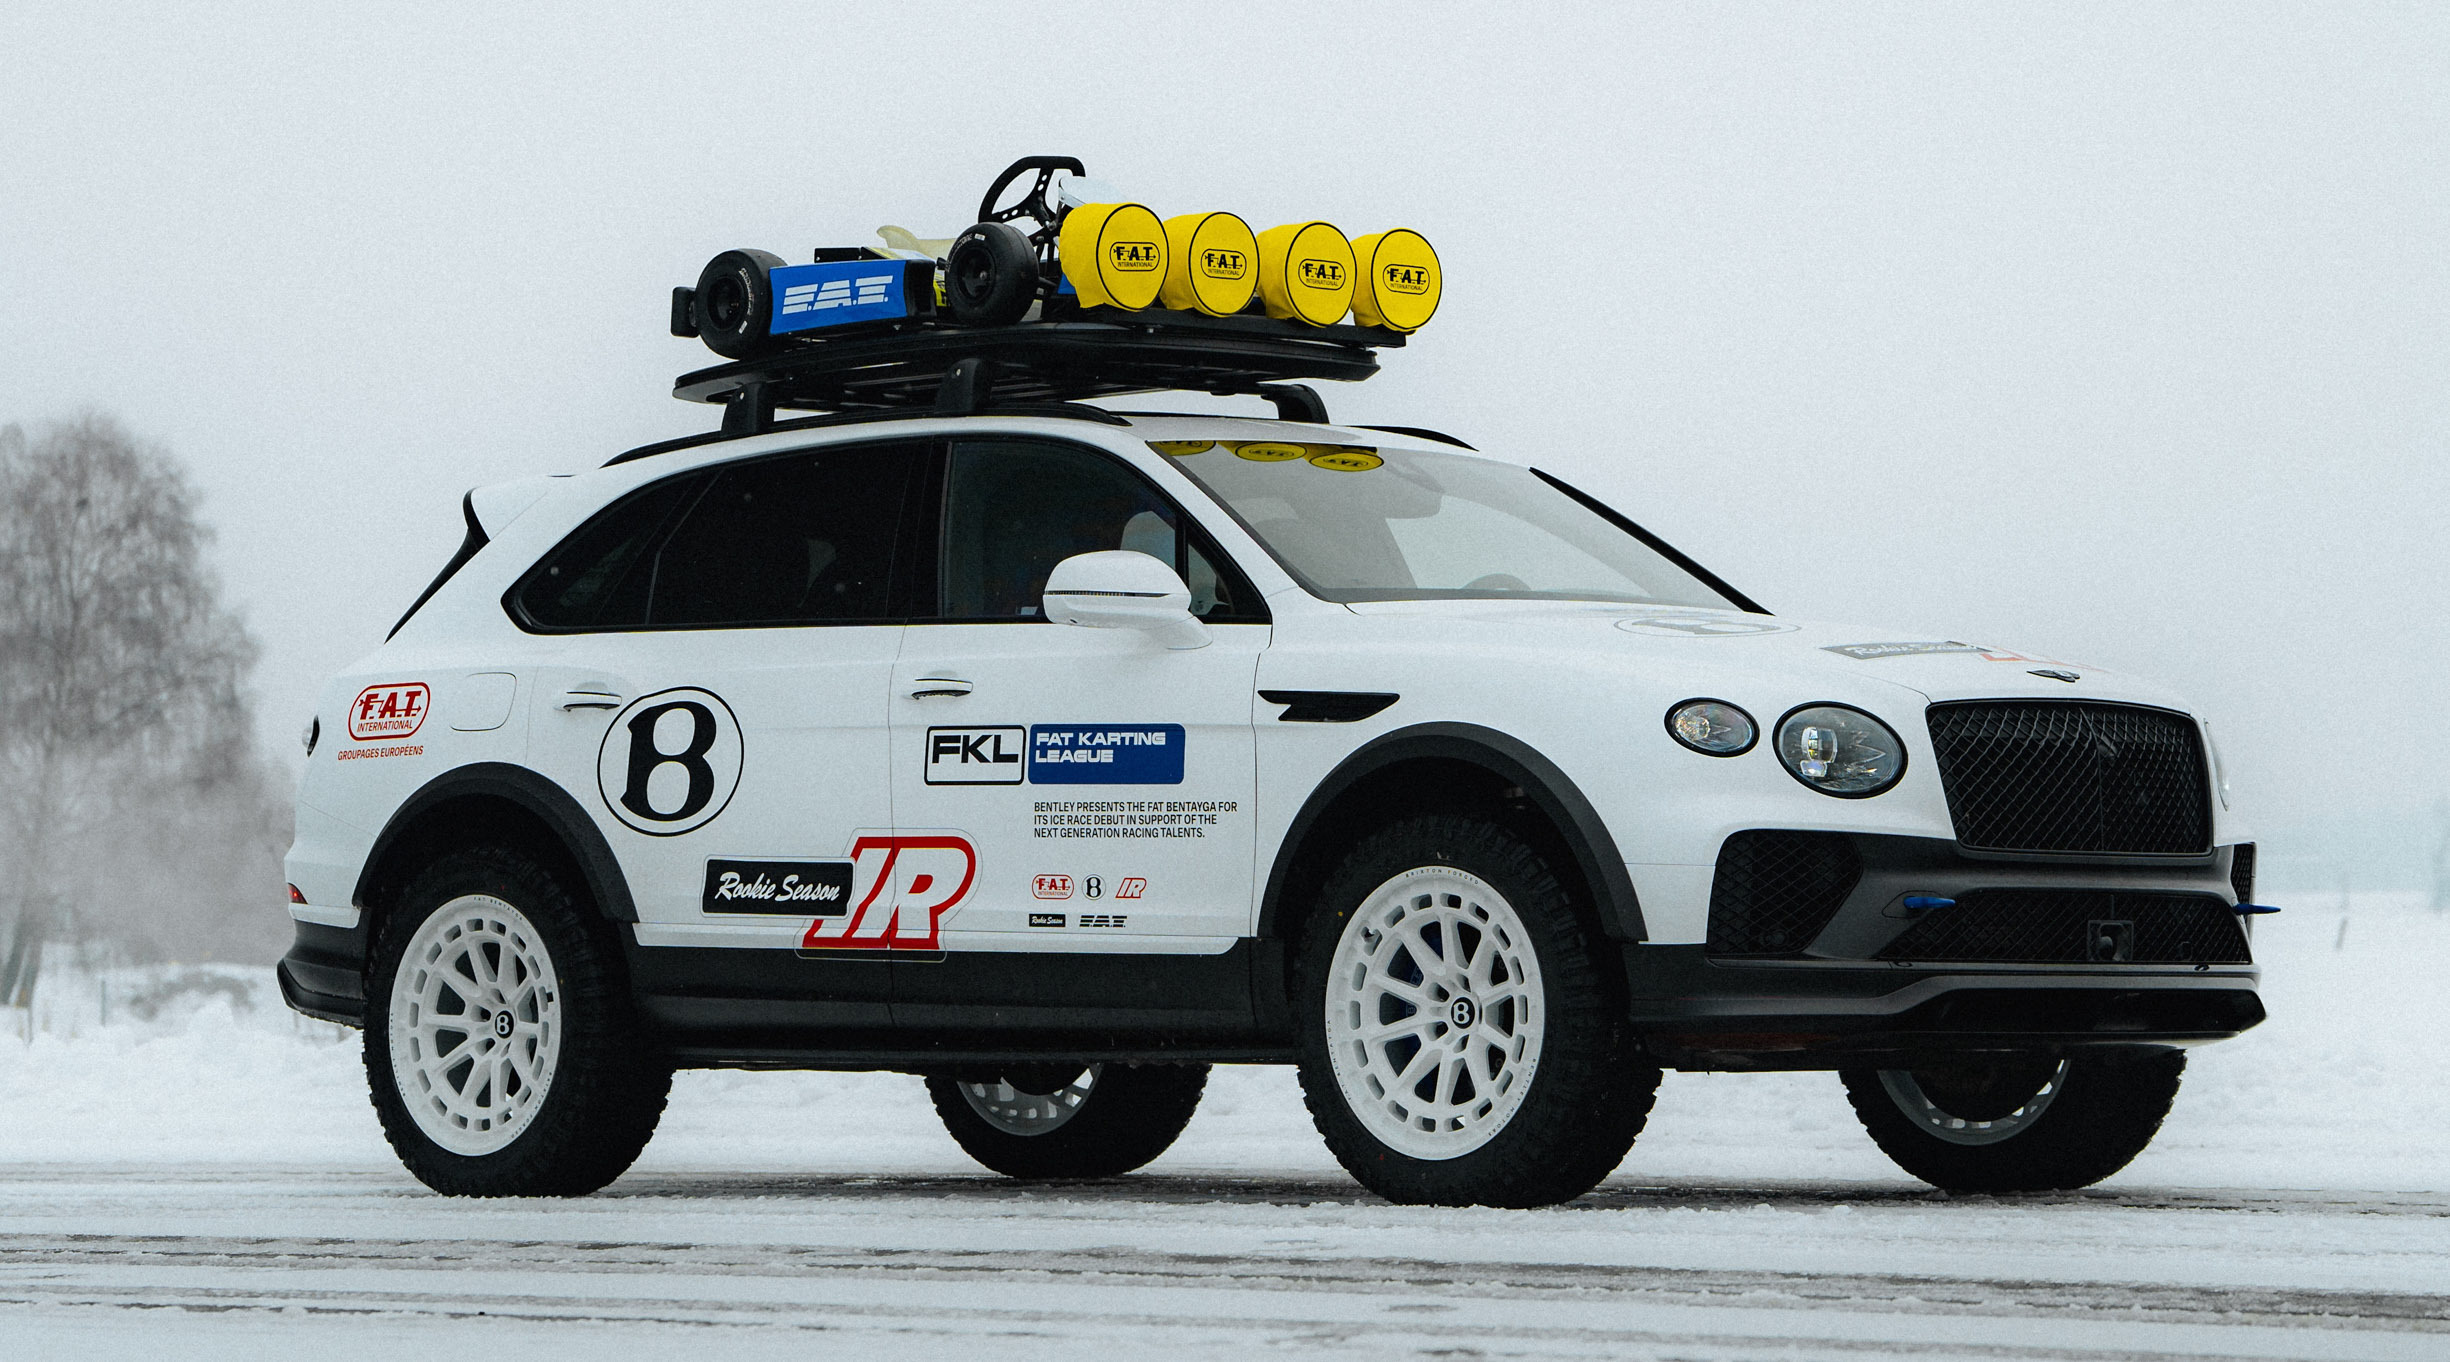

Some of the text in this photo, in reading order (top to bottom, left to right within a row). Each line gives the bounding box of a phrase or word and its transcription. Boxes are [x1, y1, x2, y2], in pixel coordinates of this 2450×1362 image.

[1115, 246, 1154, 261] F.A.T.
[1207, 253, 1241, 269] F.A.T.
[1207, 268, 1240, 276] INTERNATIONAL
[1304, 263, 1340, 281] F.A.T.
[1389, 268, 1425, 285] F.A.T.
[1305, 278, 1339, 287] INTERNATIONAL
[1390, 283, 1423, 291] INTERNATIONAL
[359, 690, 422, 720] F.A.T.
[357, 720, 413, 732] INTERNATIONAL
[1036, 732, 1166, 746] FAT KARTING
[338, 744, 424, 761] GROUPAGES EUROPÉENS
[931, 734, 1019, 764] FKL
[1035, 749, 1114, 763] LEAGUE
[1034, 801, 1237, 812] BENTLEY PRESENTS THE FAT BENTAYGA FOR
[1034, 814, 1217, 825] ITS ICE RACE DEBUT IN SUPPORT OF THE
[1034, 828, 1205, 838] NEXT GENERATION RACING TALENTS.
[715, 871, 841, 902] Rookie Season
[1036, 878, 1070, 891] F.A.T.
[1115, 877, 1147, 899] IR
